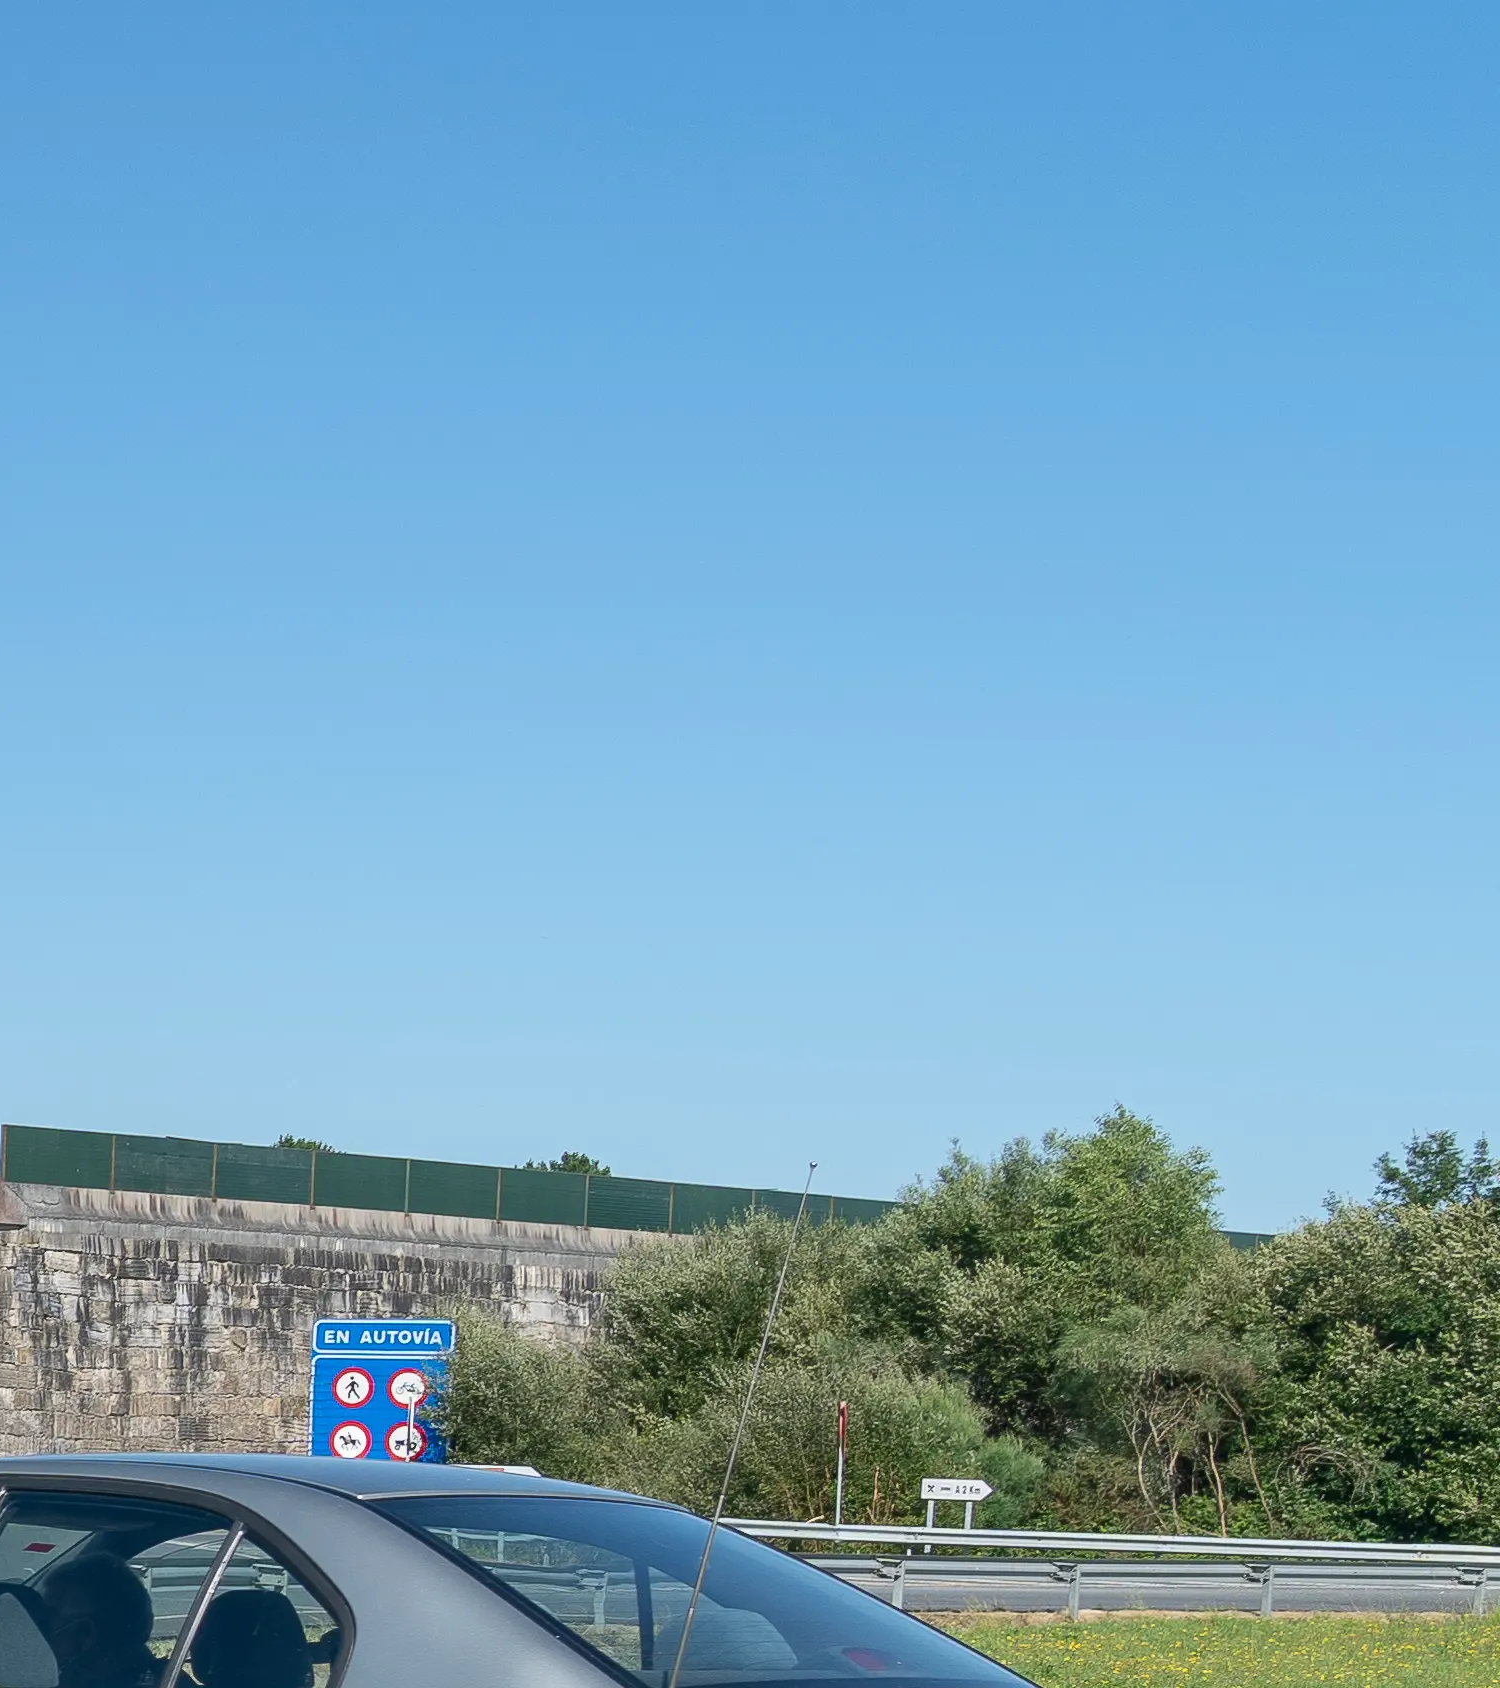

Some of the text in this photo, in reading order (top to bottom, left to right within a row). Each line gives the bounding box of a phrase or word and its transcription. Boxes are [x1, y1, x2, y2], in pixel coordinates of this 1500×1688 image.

[324, 1328, 443, 1345] EN AUTOVÍA
[962, 1485, 968, 1494] 2
